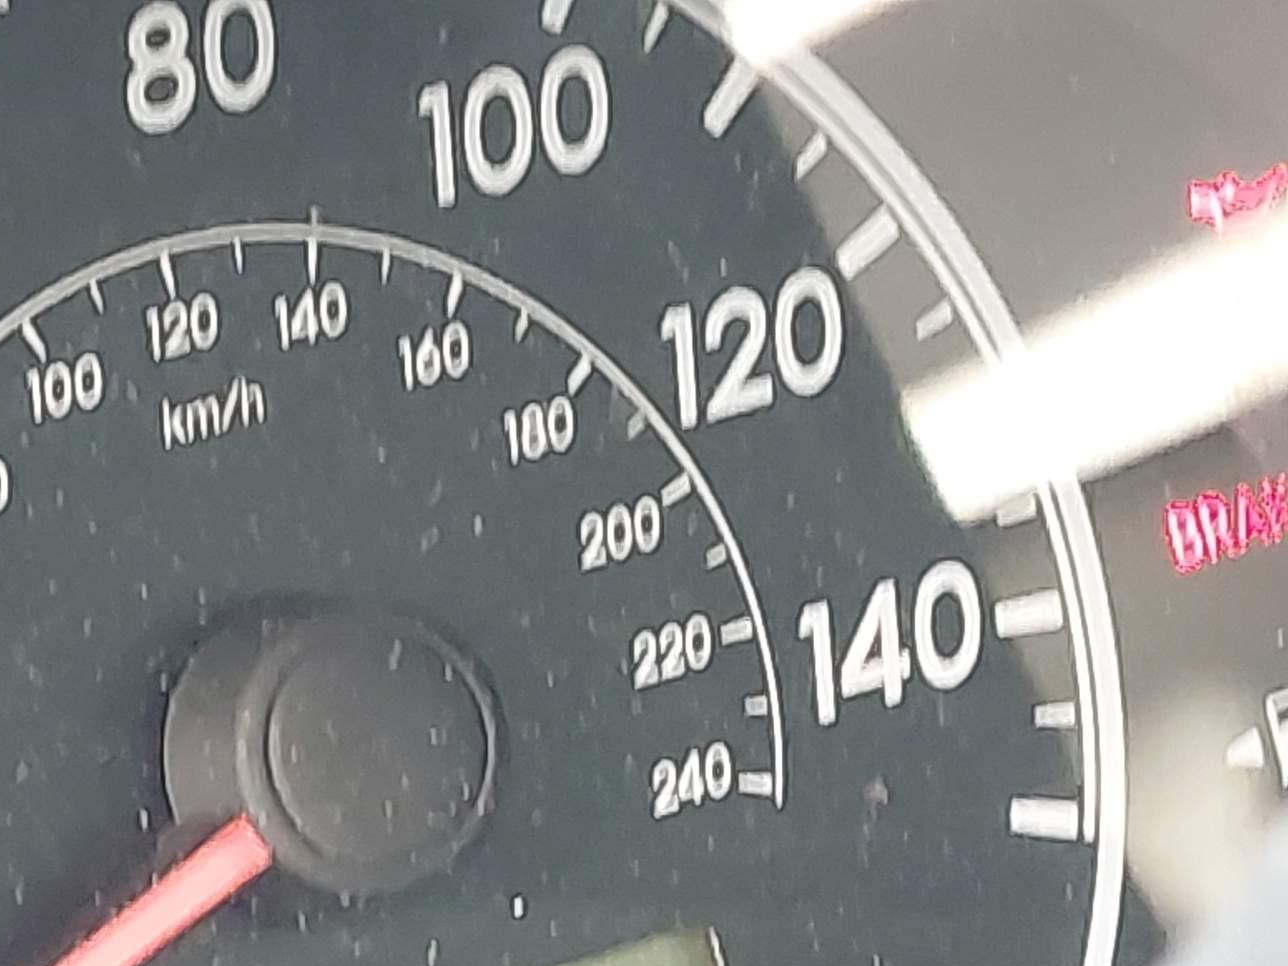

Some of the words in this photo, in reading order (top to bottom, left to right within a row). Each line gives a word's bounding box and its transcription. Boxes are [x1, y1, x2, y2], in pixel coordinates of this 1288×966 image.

[126, 0, 275, 134] 80
[418, 47, 609, 208] 100
[146, 293, 219, 363] 120
[274, 282, 348, 350] 140
[660, 267, 843, 430] 120
[27, 352, 104, 424] 100
[398, 322, 470, 391] 160
[161, 377, 265, 450] km/h
[503, 395, 575, 466] 180
[579, 495, 661, 571] 200
[633, 616, 712, 689] 220
[798, 559, 982, 726] 140
[652, 741, 733, 819] 240
